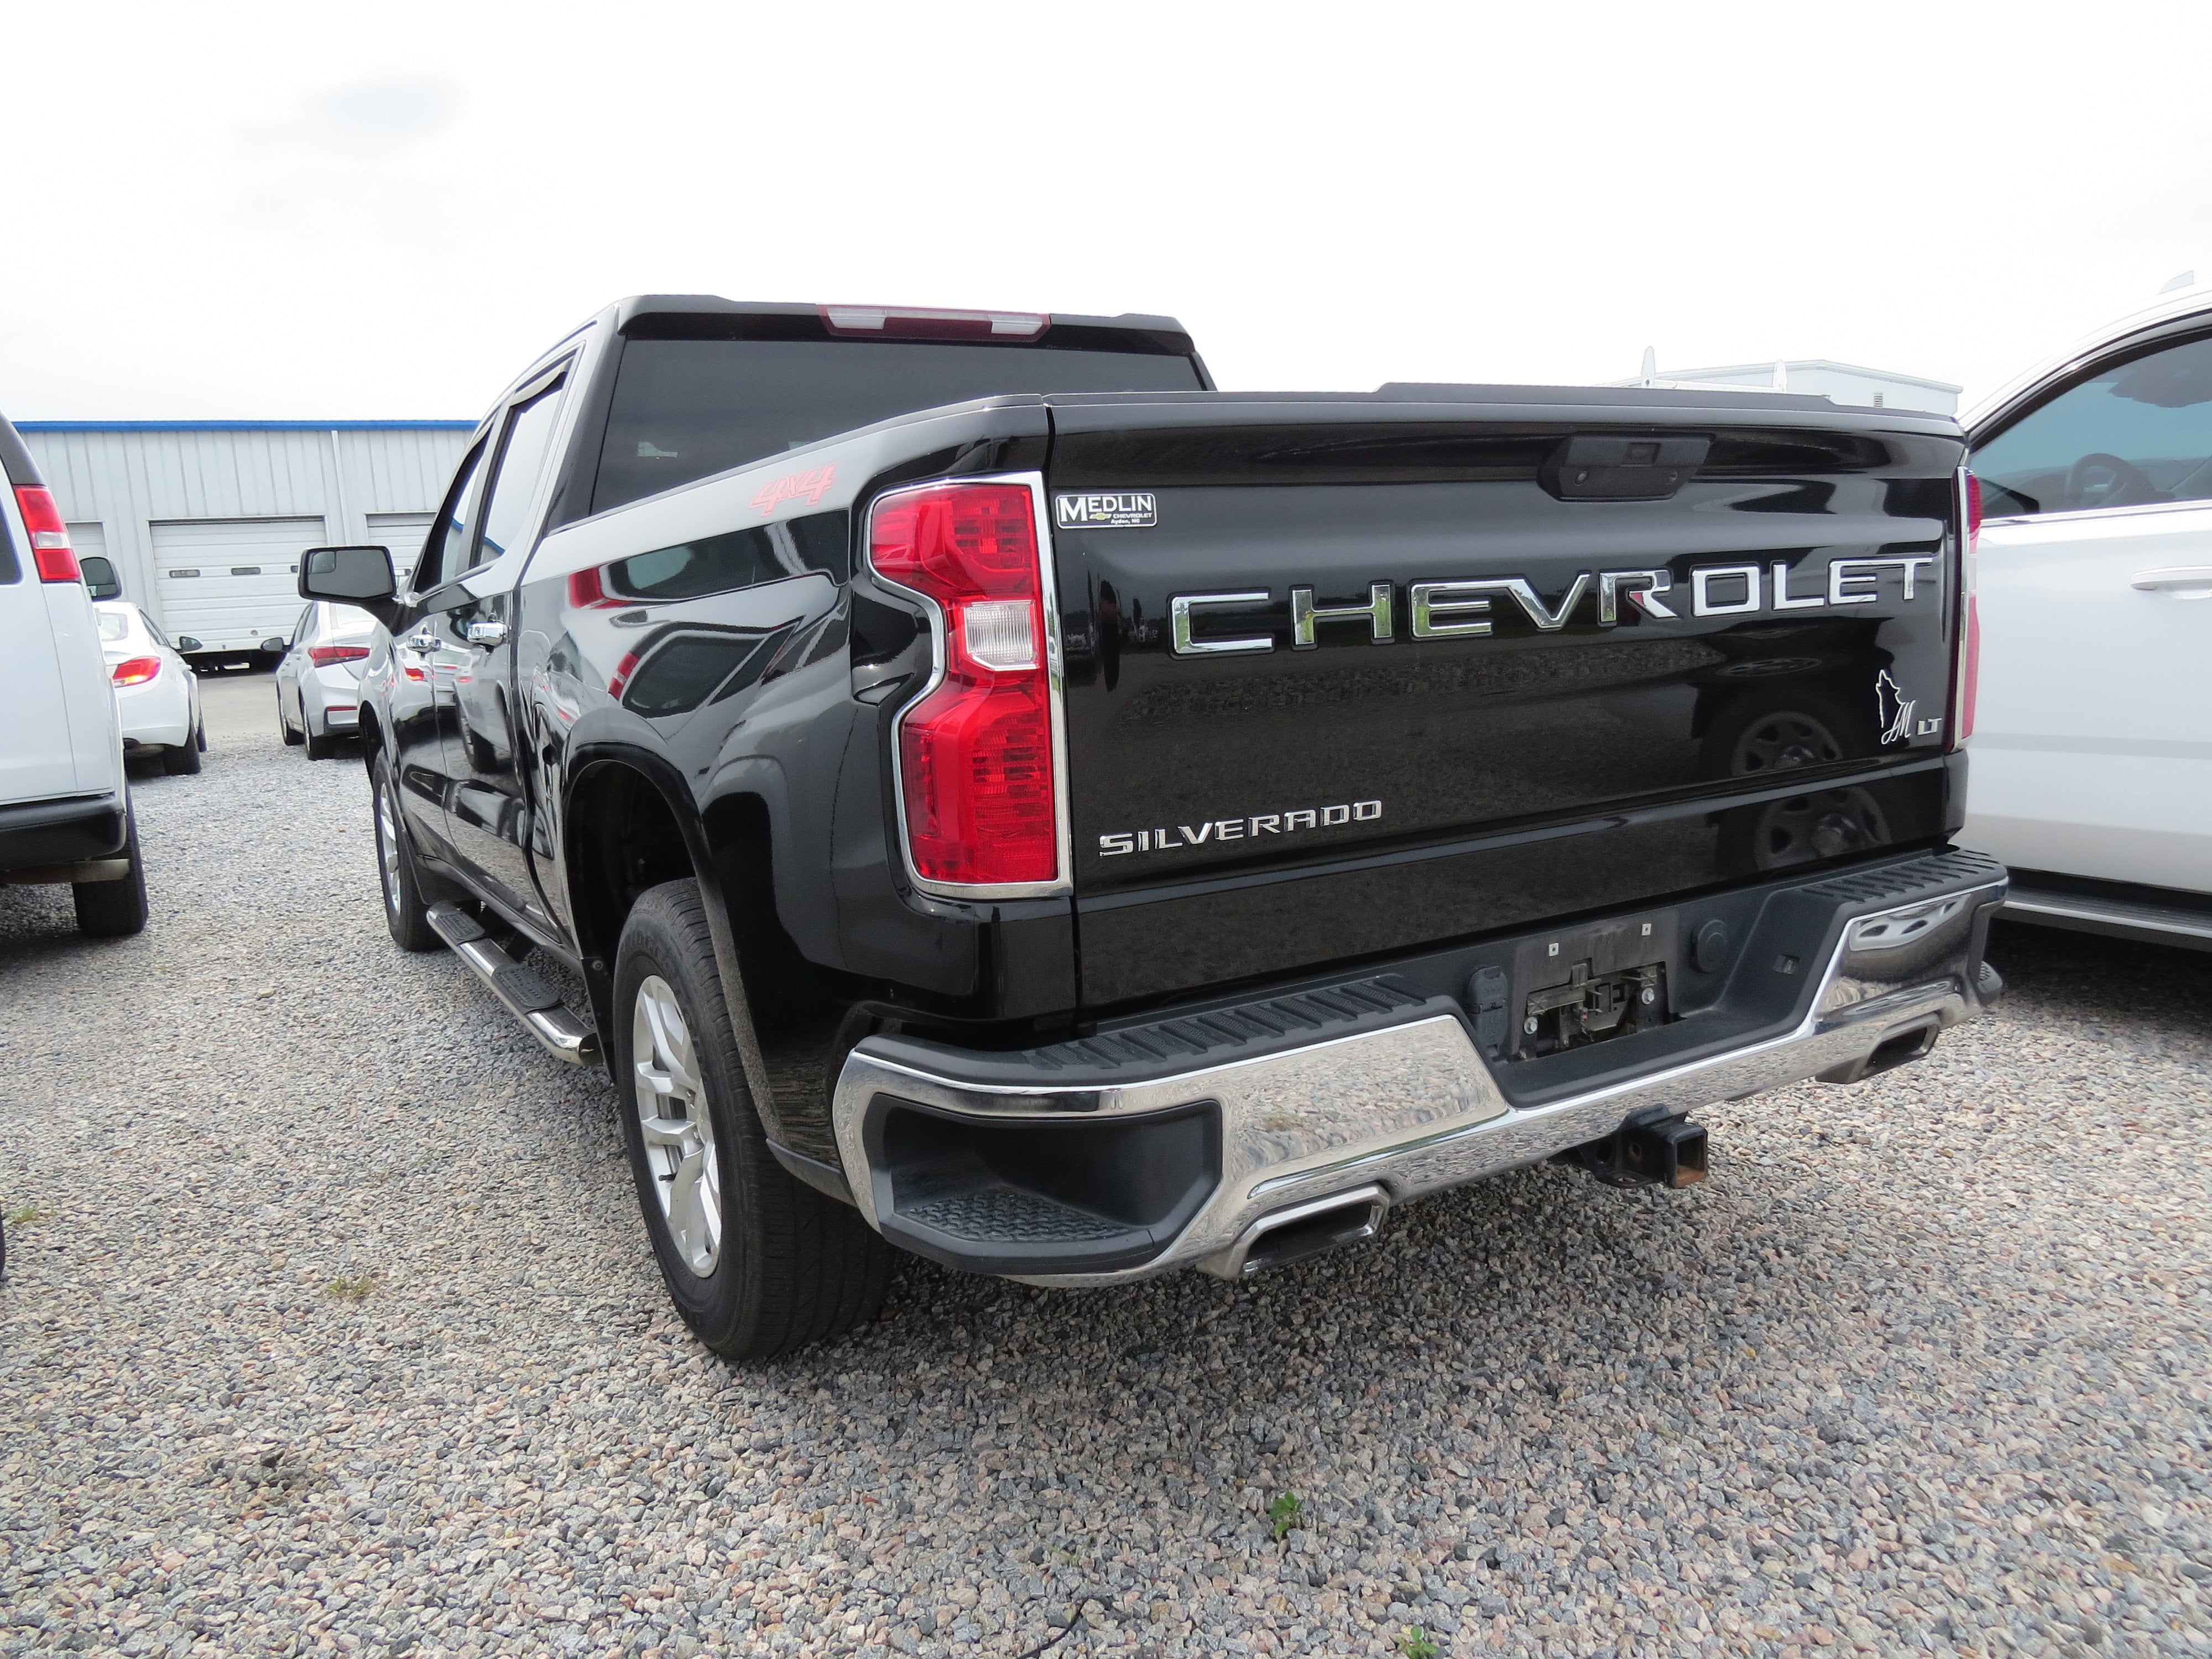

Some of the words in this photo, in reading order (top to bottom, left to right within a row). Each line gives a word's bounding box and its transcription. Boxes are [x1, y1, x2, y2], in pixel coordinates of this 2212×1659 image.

[1059, 495, 1152, 522] MEDLIN
[1171, 556, 1933, 656] CHEVROLET
[1917, 718, 1942, 735] LT
[1099, 800, 1382, 857] SILVERADO
